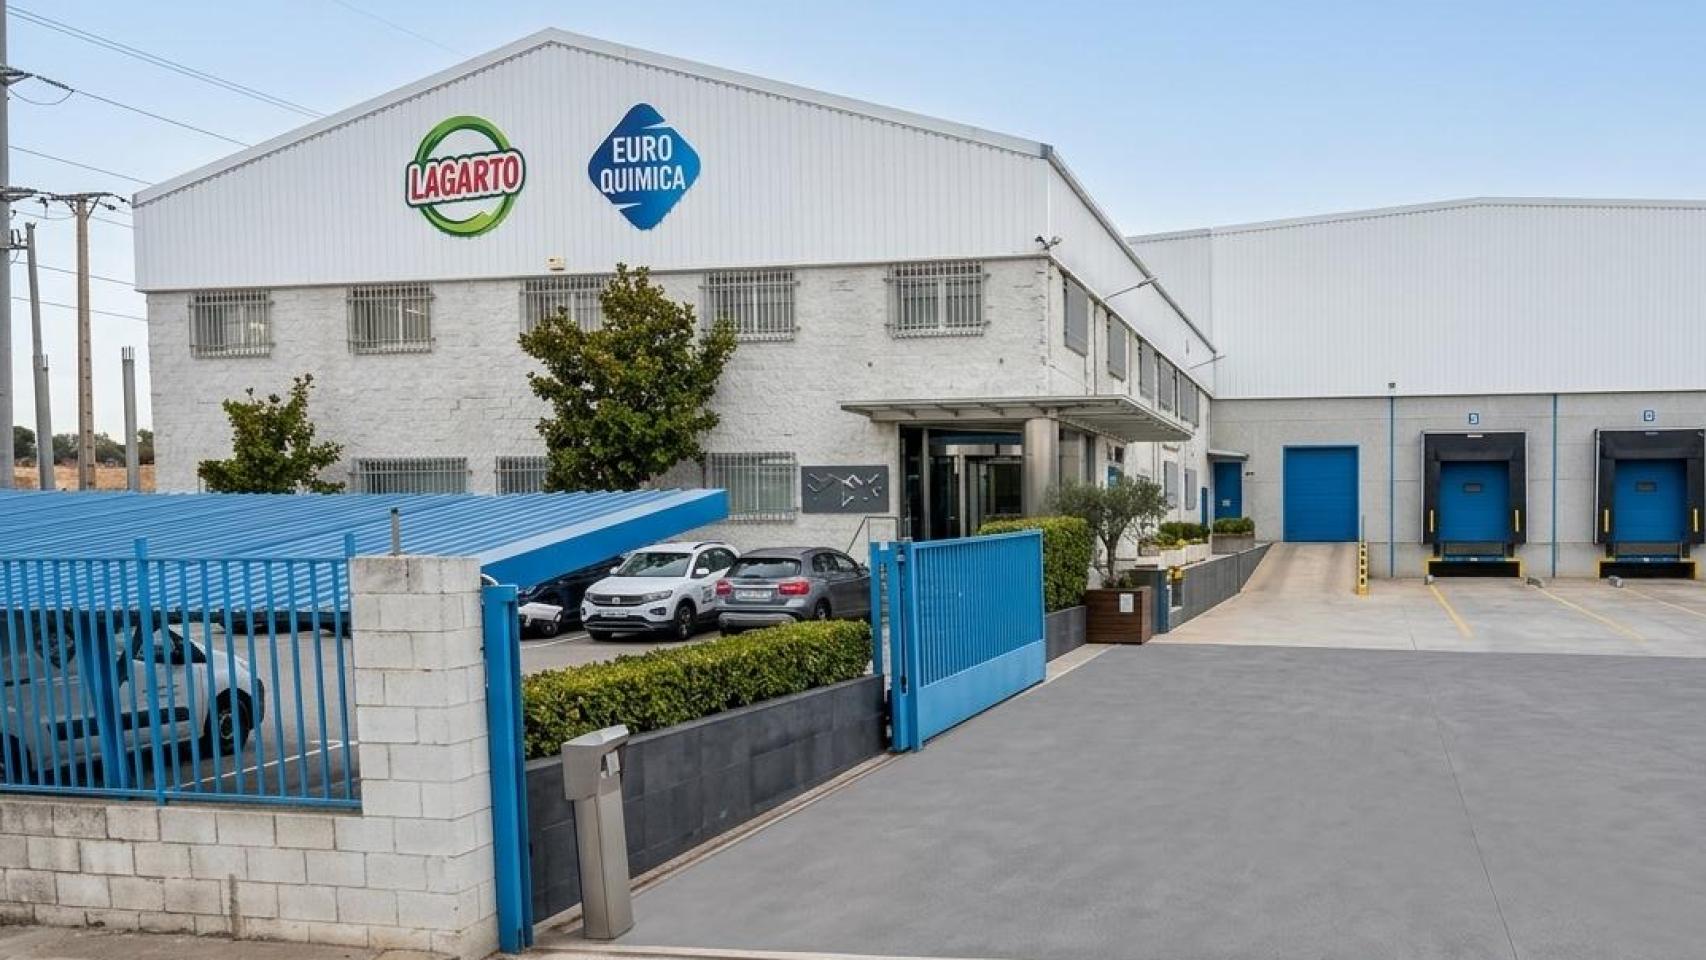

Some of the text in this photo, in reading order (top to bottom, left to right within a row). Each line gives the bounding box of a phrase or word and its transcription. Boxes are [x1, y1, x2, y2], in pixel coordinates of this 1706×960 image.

[612, 134, 673, 163] EURO
[409, 154, 521, 202] LAGARTO
[600, 164, 687, 195] QUIMICA
